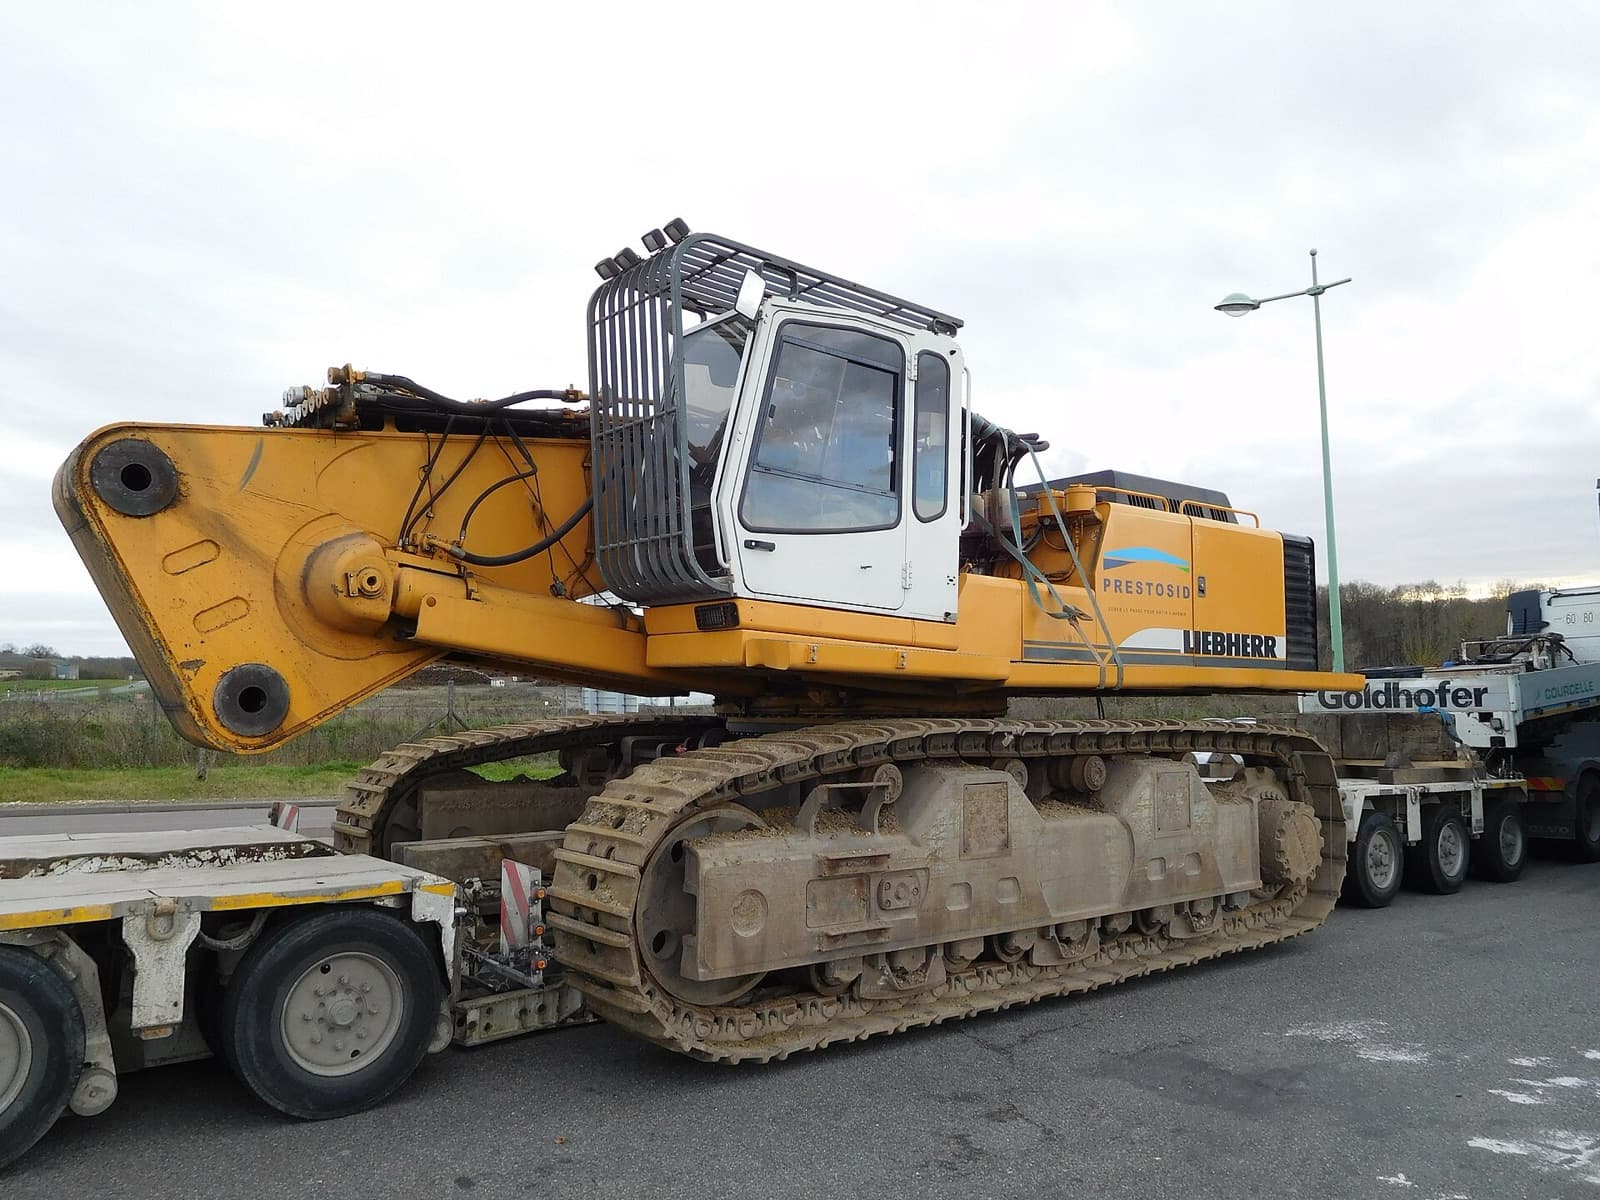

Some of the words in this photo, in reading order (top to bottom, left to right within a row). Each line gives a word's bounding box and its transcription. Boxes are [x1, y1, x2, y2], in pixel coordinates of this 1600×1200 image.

[1103, 578, 1190, 599] PRESTOSID
[1566, 613, 1576, 624] 60
[1583, 612, 1594, 623] 80
[1183, 630, 1277, 658] LIEBHERR
[1317, 680, 1489, 709] Goldhofer
